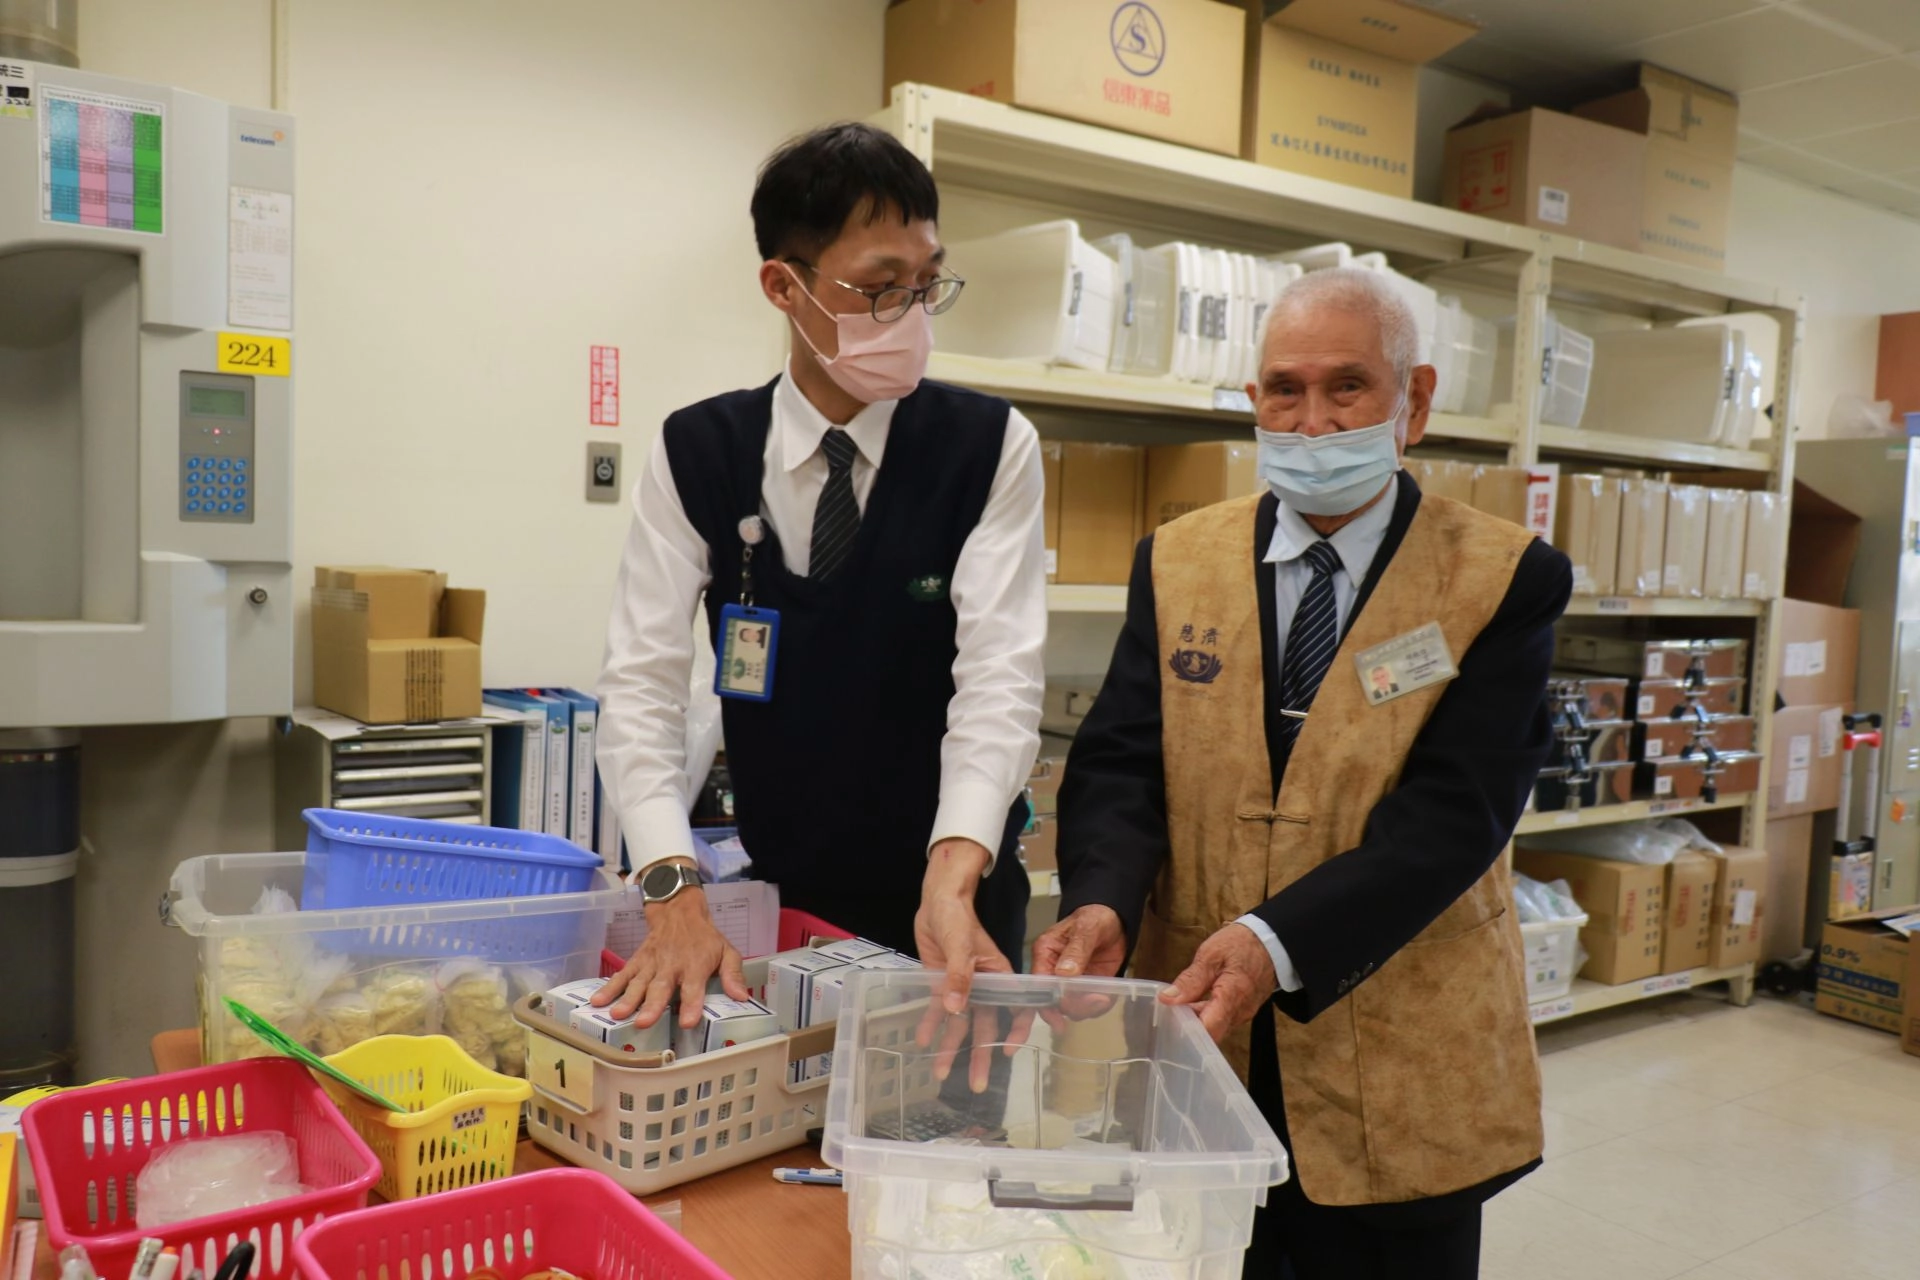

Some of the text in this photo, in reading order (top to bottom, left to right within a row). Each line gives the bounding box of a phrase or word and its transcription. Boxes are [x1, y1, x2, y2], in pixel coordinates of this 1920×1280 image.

[1129, 24, 1147, 54] S
[240, 134, 276, 147] telecom
[228, 341, 277, 368] 224
[1179, 623, 1219, 646] 慈濟
[1822, 944, 1861, 963] 0.9%
[555, 1058, 566, 1089] 1
